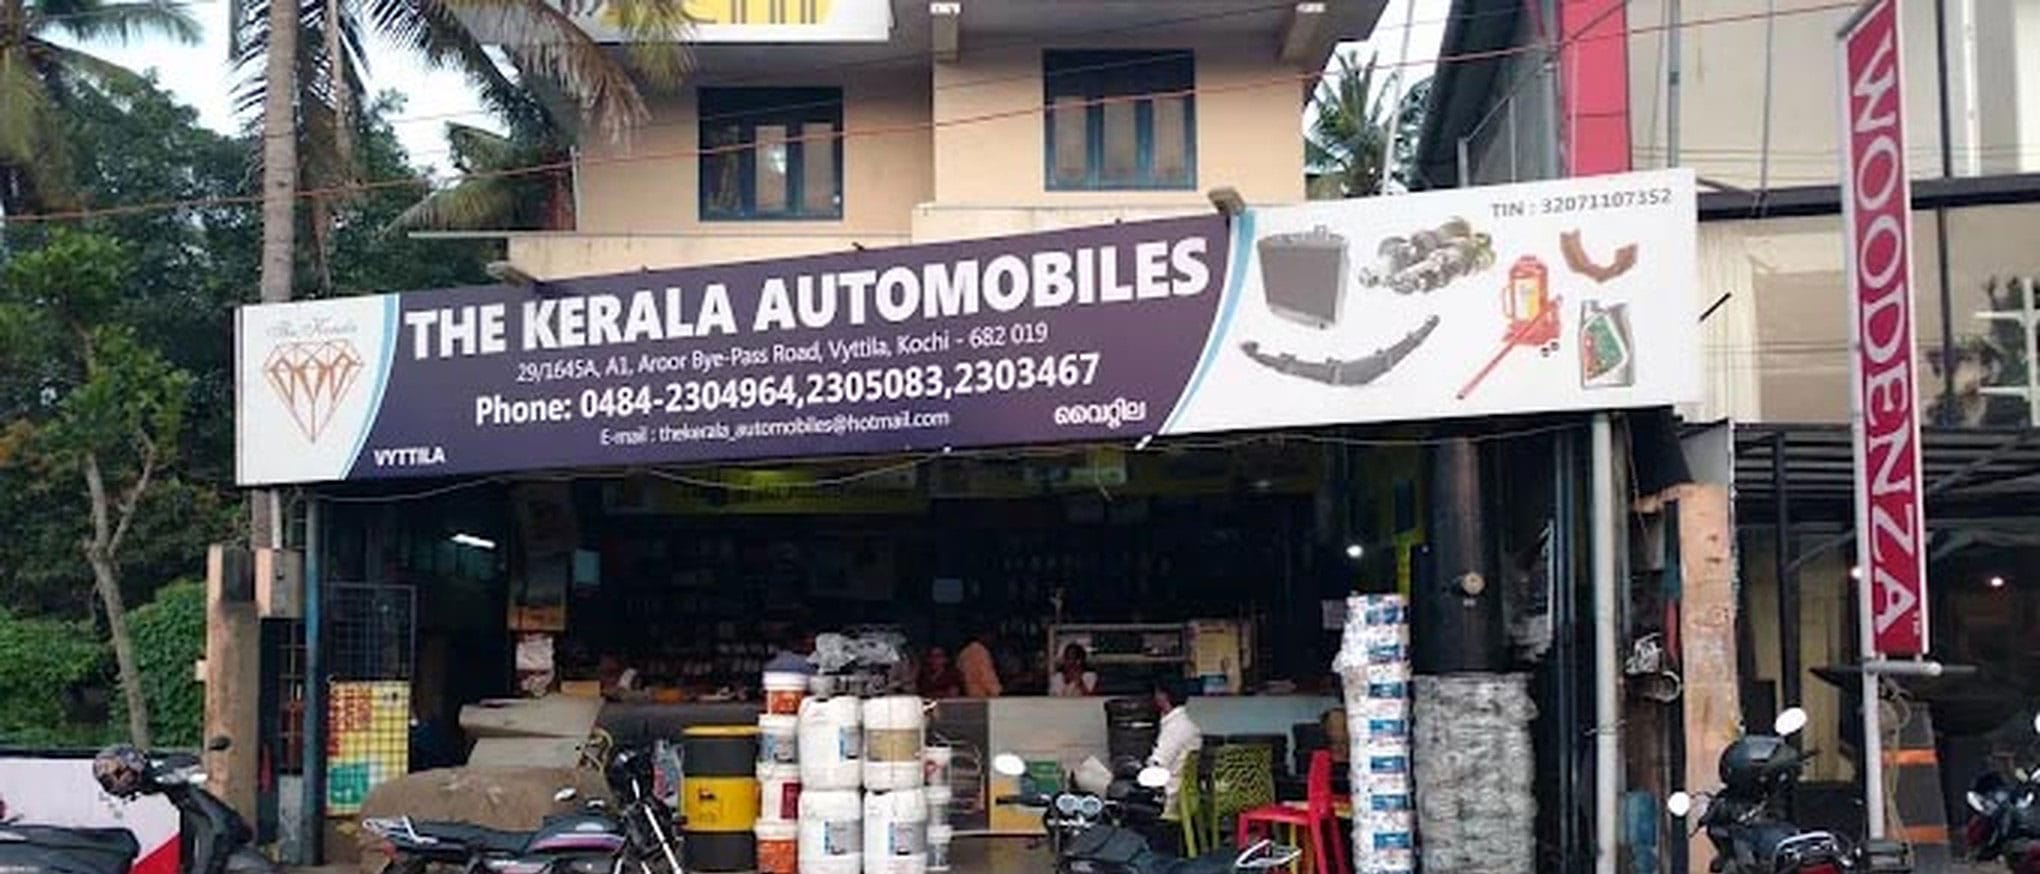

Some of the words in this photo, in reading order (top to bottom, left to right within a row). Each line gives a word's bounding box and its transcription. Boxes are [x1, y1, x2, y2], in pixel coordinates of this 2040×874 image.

[1492, 202, 1525, 218] TIN
[405, 304, 506, 360] THE
[522, 283, 738, 351] KERALA
[752, 237, 1210, 332] AUTOMOBILES
[637, 352, 688, 374] Aroor
[691, 346, 769, 373] Bye-Pass
[772, 343, 822, 364] Road,
[827, 334, 892, 365] Vyttila,
[896, 329, 950, 356] Kochi
[969, 325, 1007, 349] 682
[1010, 322, 1049, 344] 019
[1852, 26, 1918, 636] WOODENZA
[475, 394, 573, 426] Phone:
[579, 352, 1101, 420] 0484-2304964,2305083,2303467
[600, 427, 648, 447] E-mail
[658, 409, 950, 444] thekerala_automobiles@hotmail.com
[373, 446, 447, 467] VYTTILA
